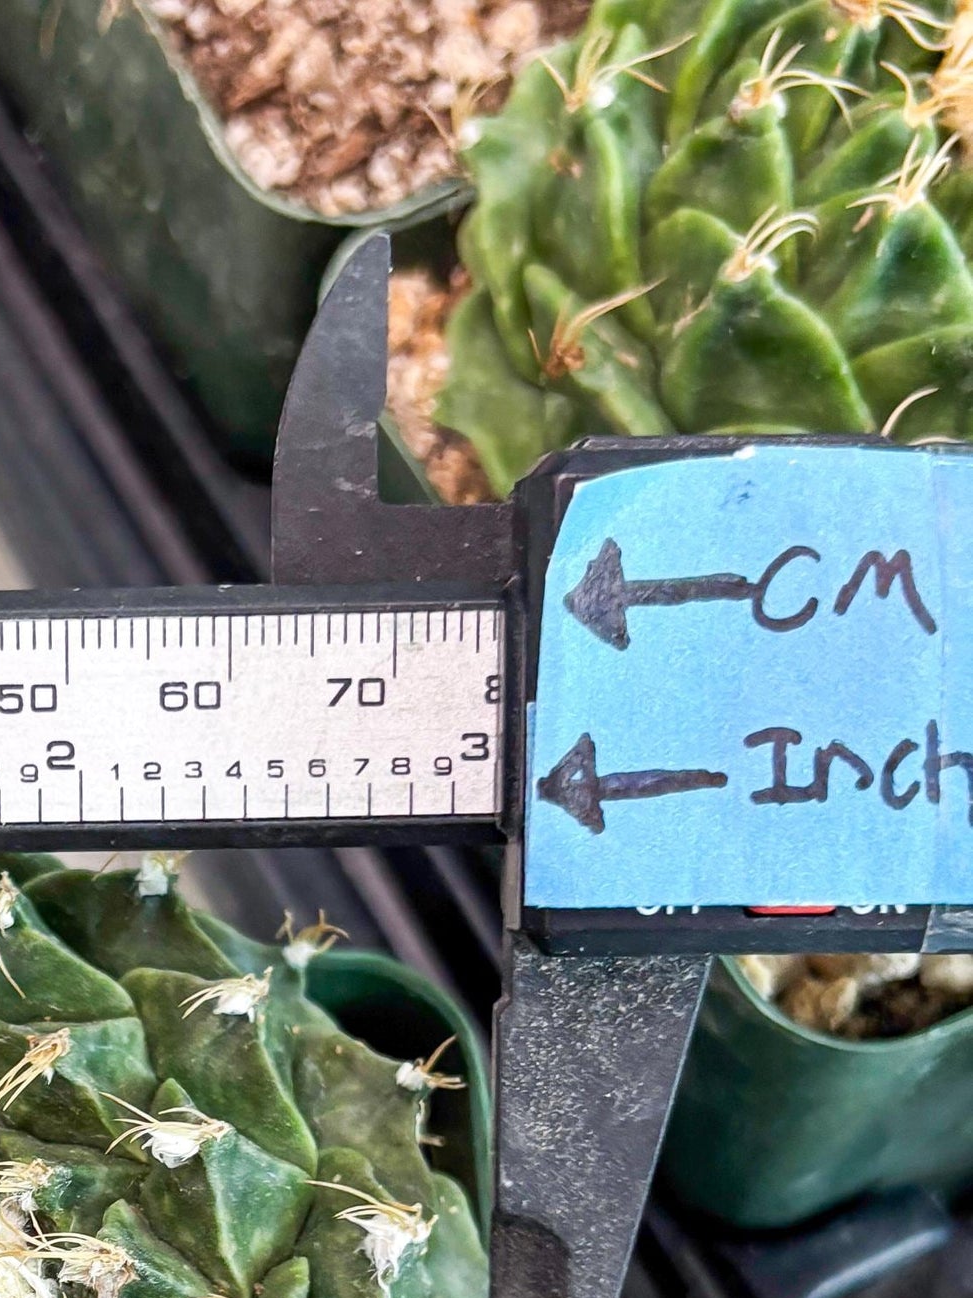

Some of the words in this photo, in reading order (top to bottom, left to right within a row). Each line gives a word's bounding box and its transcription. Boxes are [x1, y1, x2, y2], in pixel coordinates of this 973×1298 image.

[159, 681, 222, 712] 60
[326, 677, 386, 707] 70
[46, 740, 76, 770] 2
[460, 732, 490, 762] 3
[20, 763, 39, 783] 9
[111, 763, 119, 780] 1
[143, 761, 162, 781] 2
[185, 761, 203, 779] 3
[225, 760, 242, 779] 4
[267, 759, 284, 779] 5
[308, 758, 327, 778] 6
[354, 758, 370, 776] 7
[390, 757, 411, 776] 8
[433, 756, 453, 777] 9
[743, 718, 973, 829] Inch
